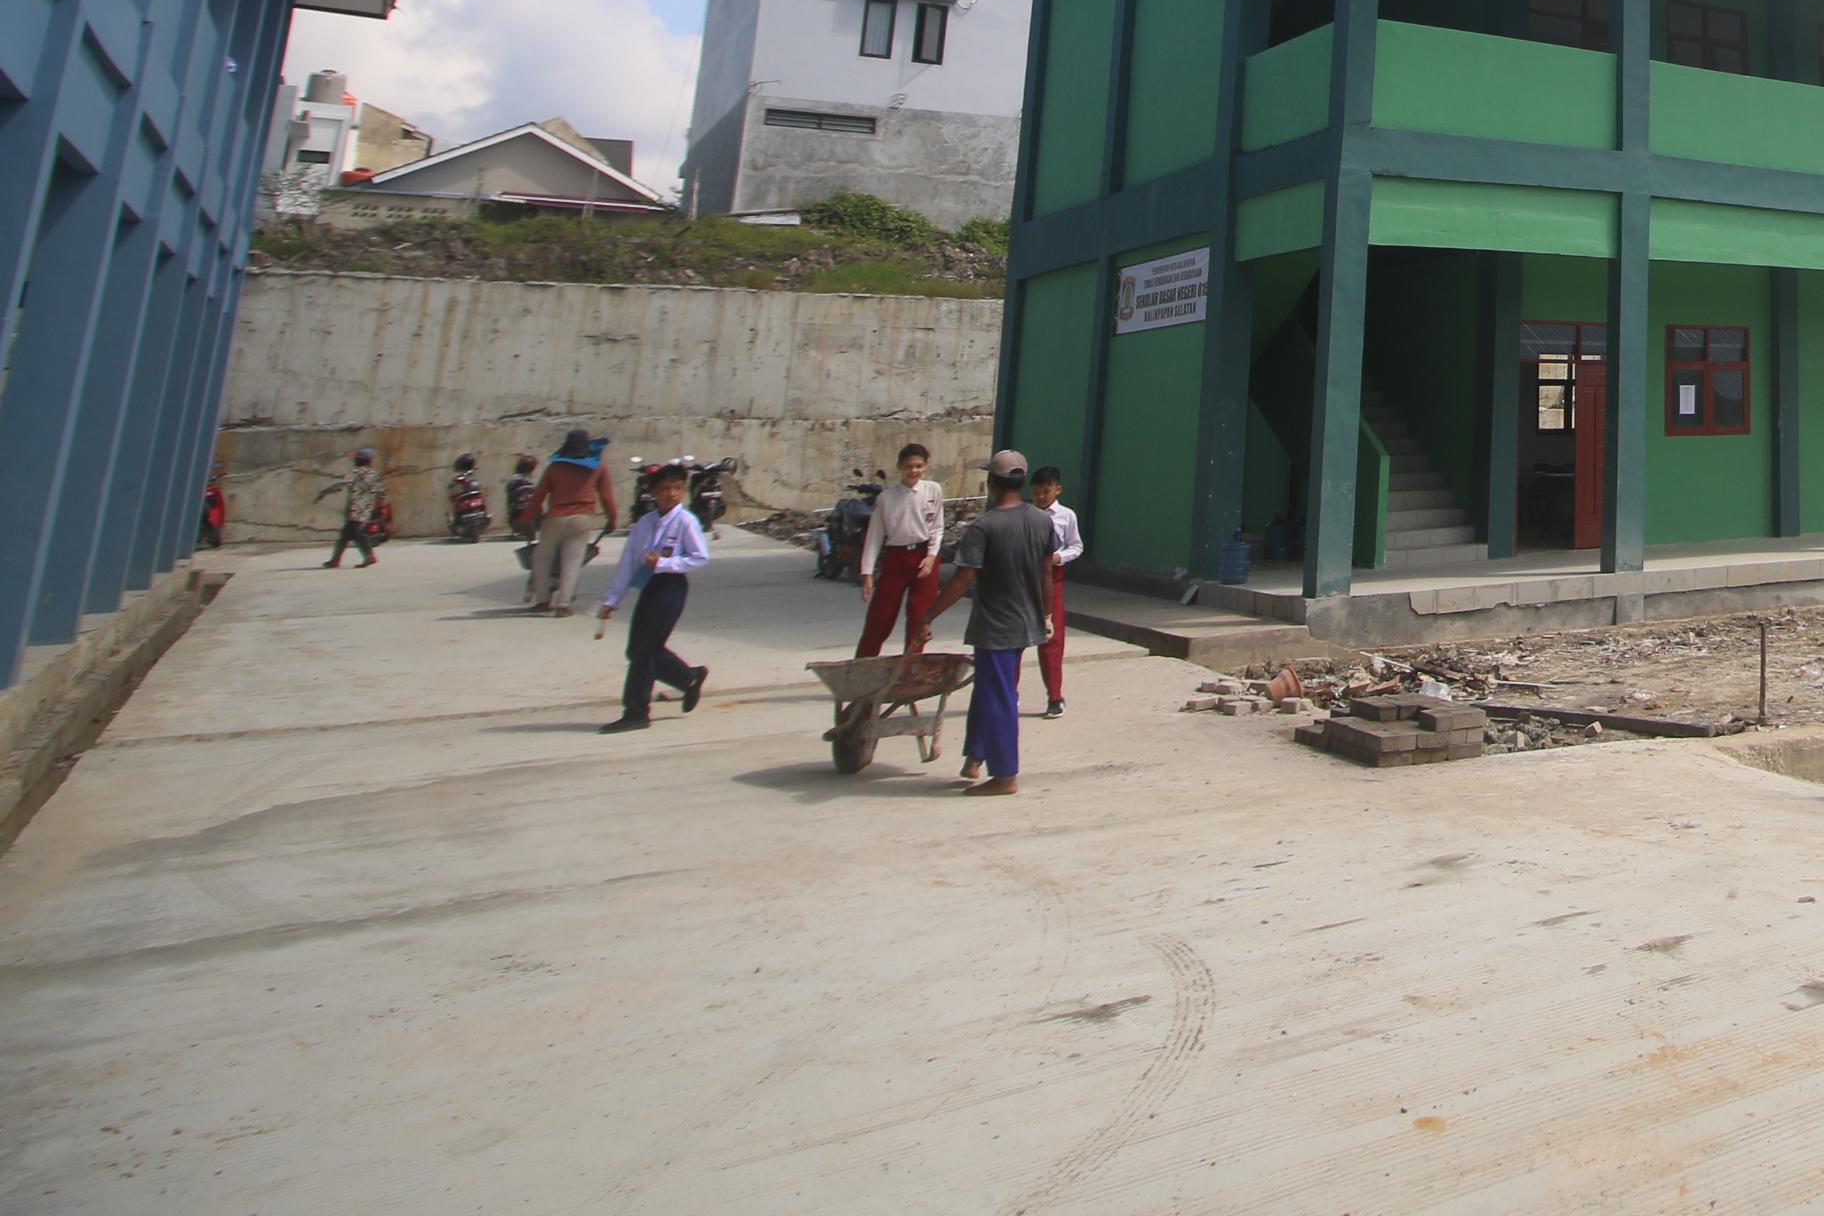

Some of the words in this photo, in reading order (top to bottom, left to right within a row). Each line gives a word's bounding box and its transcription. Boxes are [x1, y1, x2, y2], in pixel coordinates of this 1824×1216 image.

[1136, 291, 1158, 309] SEKOLAH
[1158, 288, 1176, 304] DASAR
[1177, 283, 1197, 301] NEGERI
[1174, 302, 1197, 317] SELATAN
